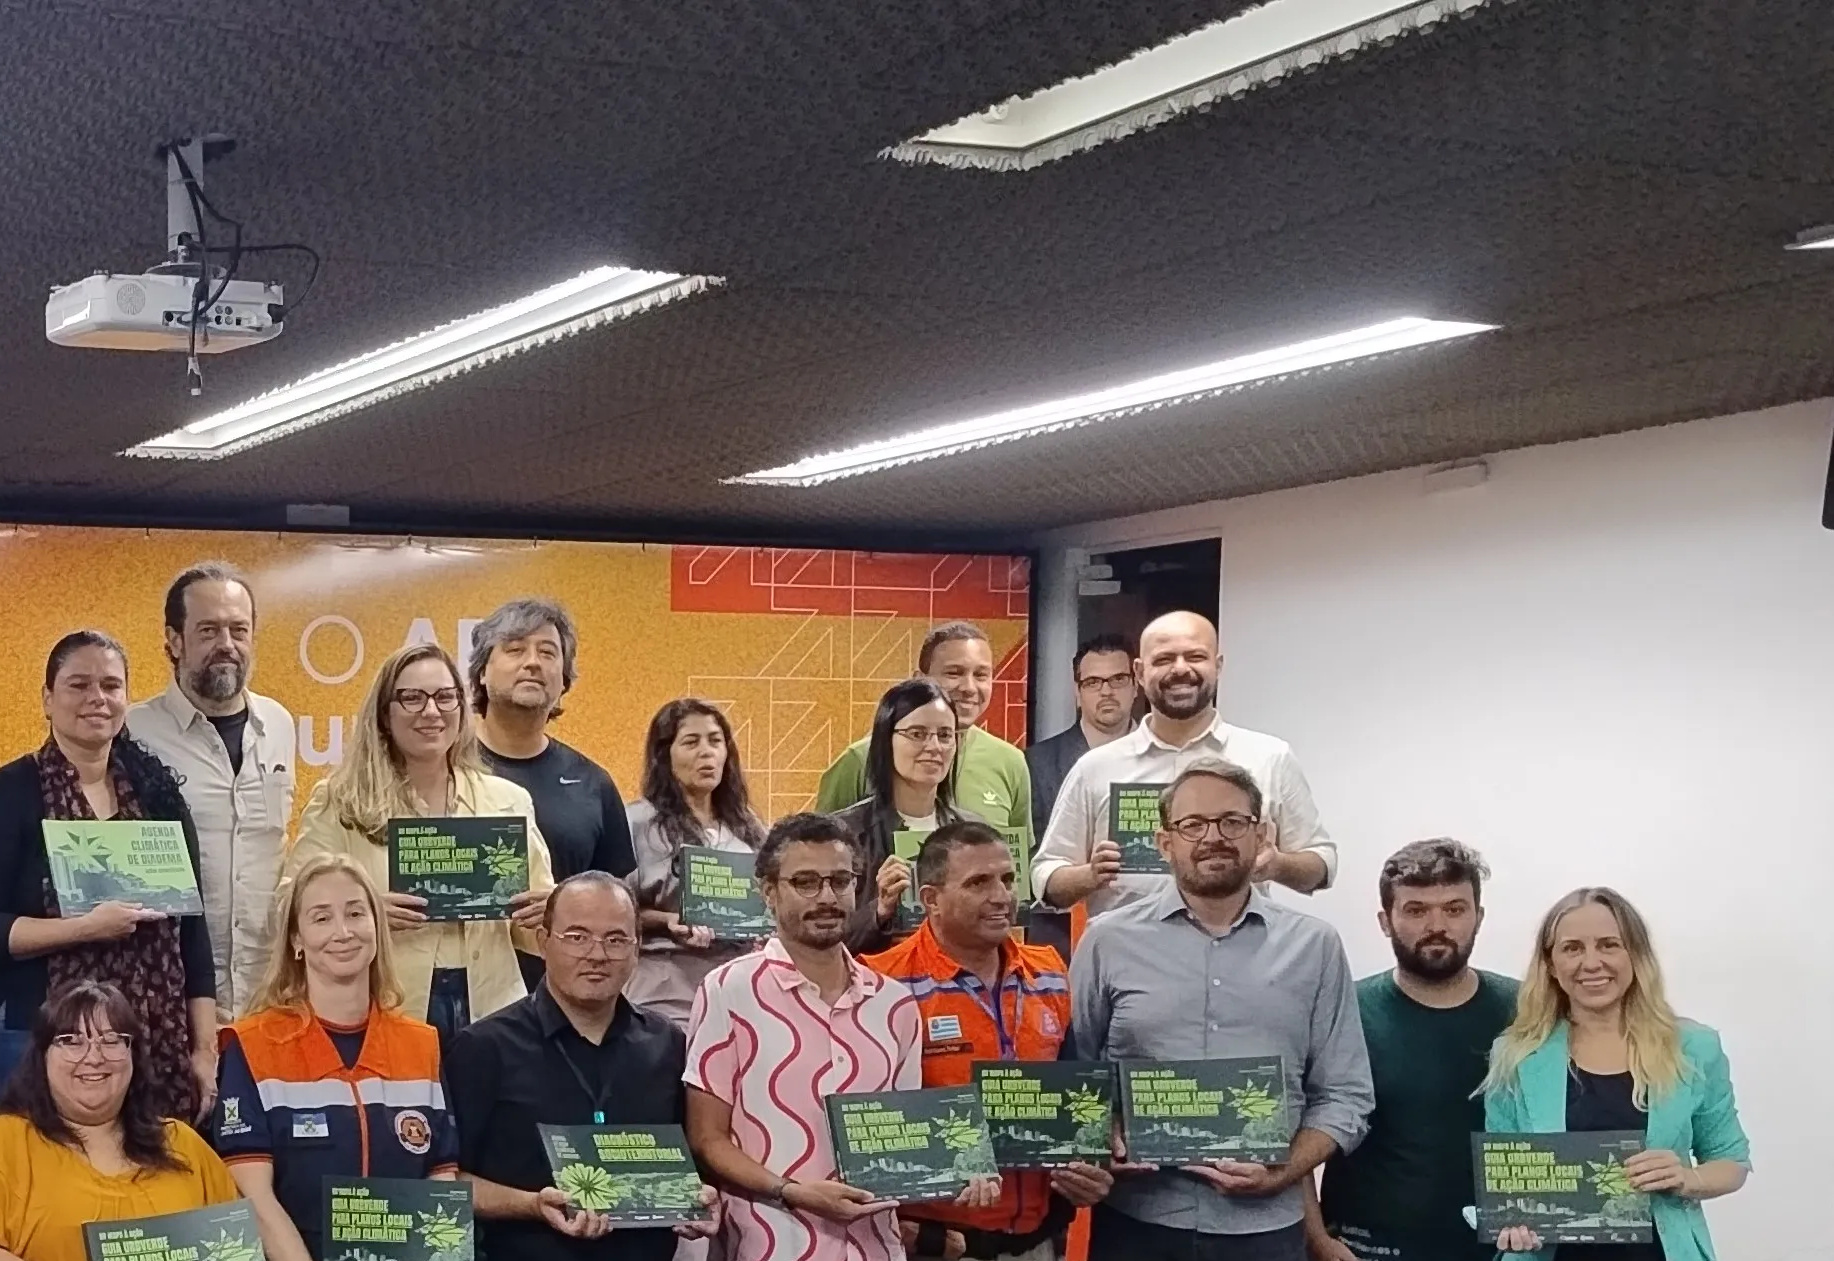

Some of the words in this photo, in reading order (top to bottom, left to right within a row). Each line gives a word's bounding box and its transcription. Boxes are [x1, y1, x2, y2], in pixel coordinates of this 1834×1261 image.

[141, 826, 176, 837] AGENDA
[131, 838, 179, 850] CLIMÁTICA
[399, 837, 416, 848] GUIA
[418, 835, 456, 847] URBVERDE
[127, 854, 139, 865] DE
[141, 853, 183, 865] DIADEMA
[399, 849, 419, 860] PARA
[421, 848, 450, 859] PLANOS
[452, 848, 478, 859] LOCAIS
[399, 862, 409, 873] DE
[411, 860, 431, 876] AÇÃO
[433, 859, 473, 872] CLIMÁTICA
[593, 1130, 656, 1146] DIAGNÓSTICO
[1484, 1153, 1506, 1164] GUIA
[1507, 1151, 1555, 1164] URBVERDE
[1485, 1166, 1510, 1177] PARA
[1511, 1165, 1548, 1177] PLANOS
[1550, 1165, 1583, 1177] LOCAIS
[1486, 1179, 1499, 1190] DE
[1500, 1178, 1525, 1194] AÇÃO
[1527, 1178, 1577, 1190] CLIMÁTICA
[332, 1198, 349, 1210] GUIA
[351, 1199, 389, 1211] URBVERDE
[332, 1213, 352, 1224] PARA
[354, 1213, 384, 1225] PLANOS
[385, 1214, 412, 1226] LOCAIS
[333, 1227, 343, 1239] DE
[344, 1225, 364, 1243] AÇÃO
[366, 1227, 407, 1242] CLIMÁTICA
[101, 1242, 122, 1256] GUIA
[123, 1235, 170, 1254] URBVERDE
